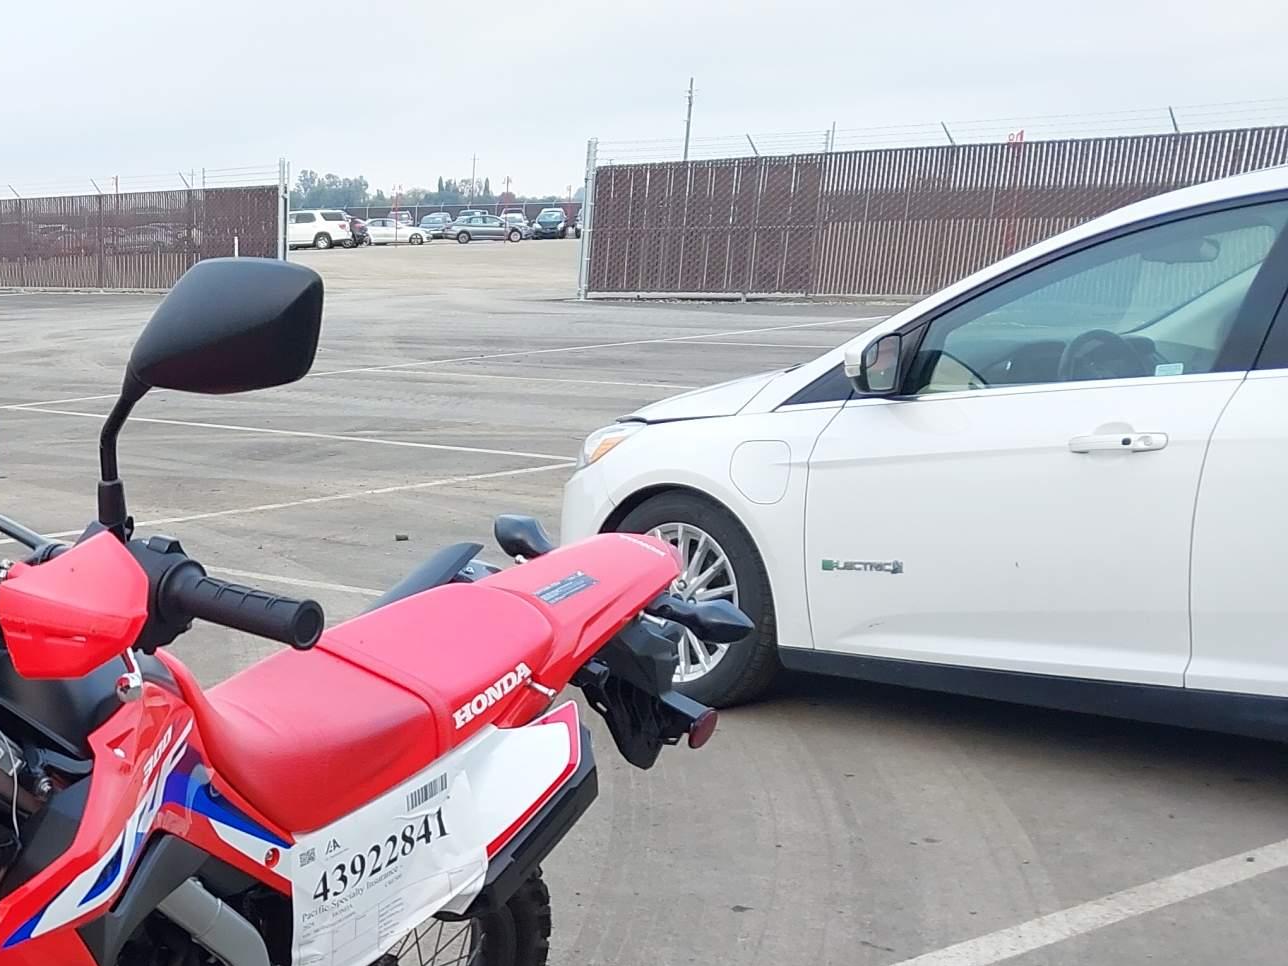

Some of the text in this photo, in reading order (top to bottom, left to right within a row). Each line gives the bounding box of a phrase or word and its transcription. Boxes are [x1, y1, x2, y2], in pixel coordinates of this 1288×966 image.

[452, 662, 532, 730] HONDA
[313, 806, 450, 902] 43922841
[302, 904, 330, 923] Pacific
[330, 887, 364, 910] Specialty
